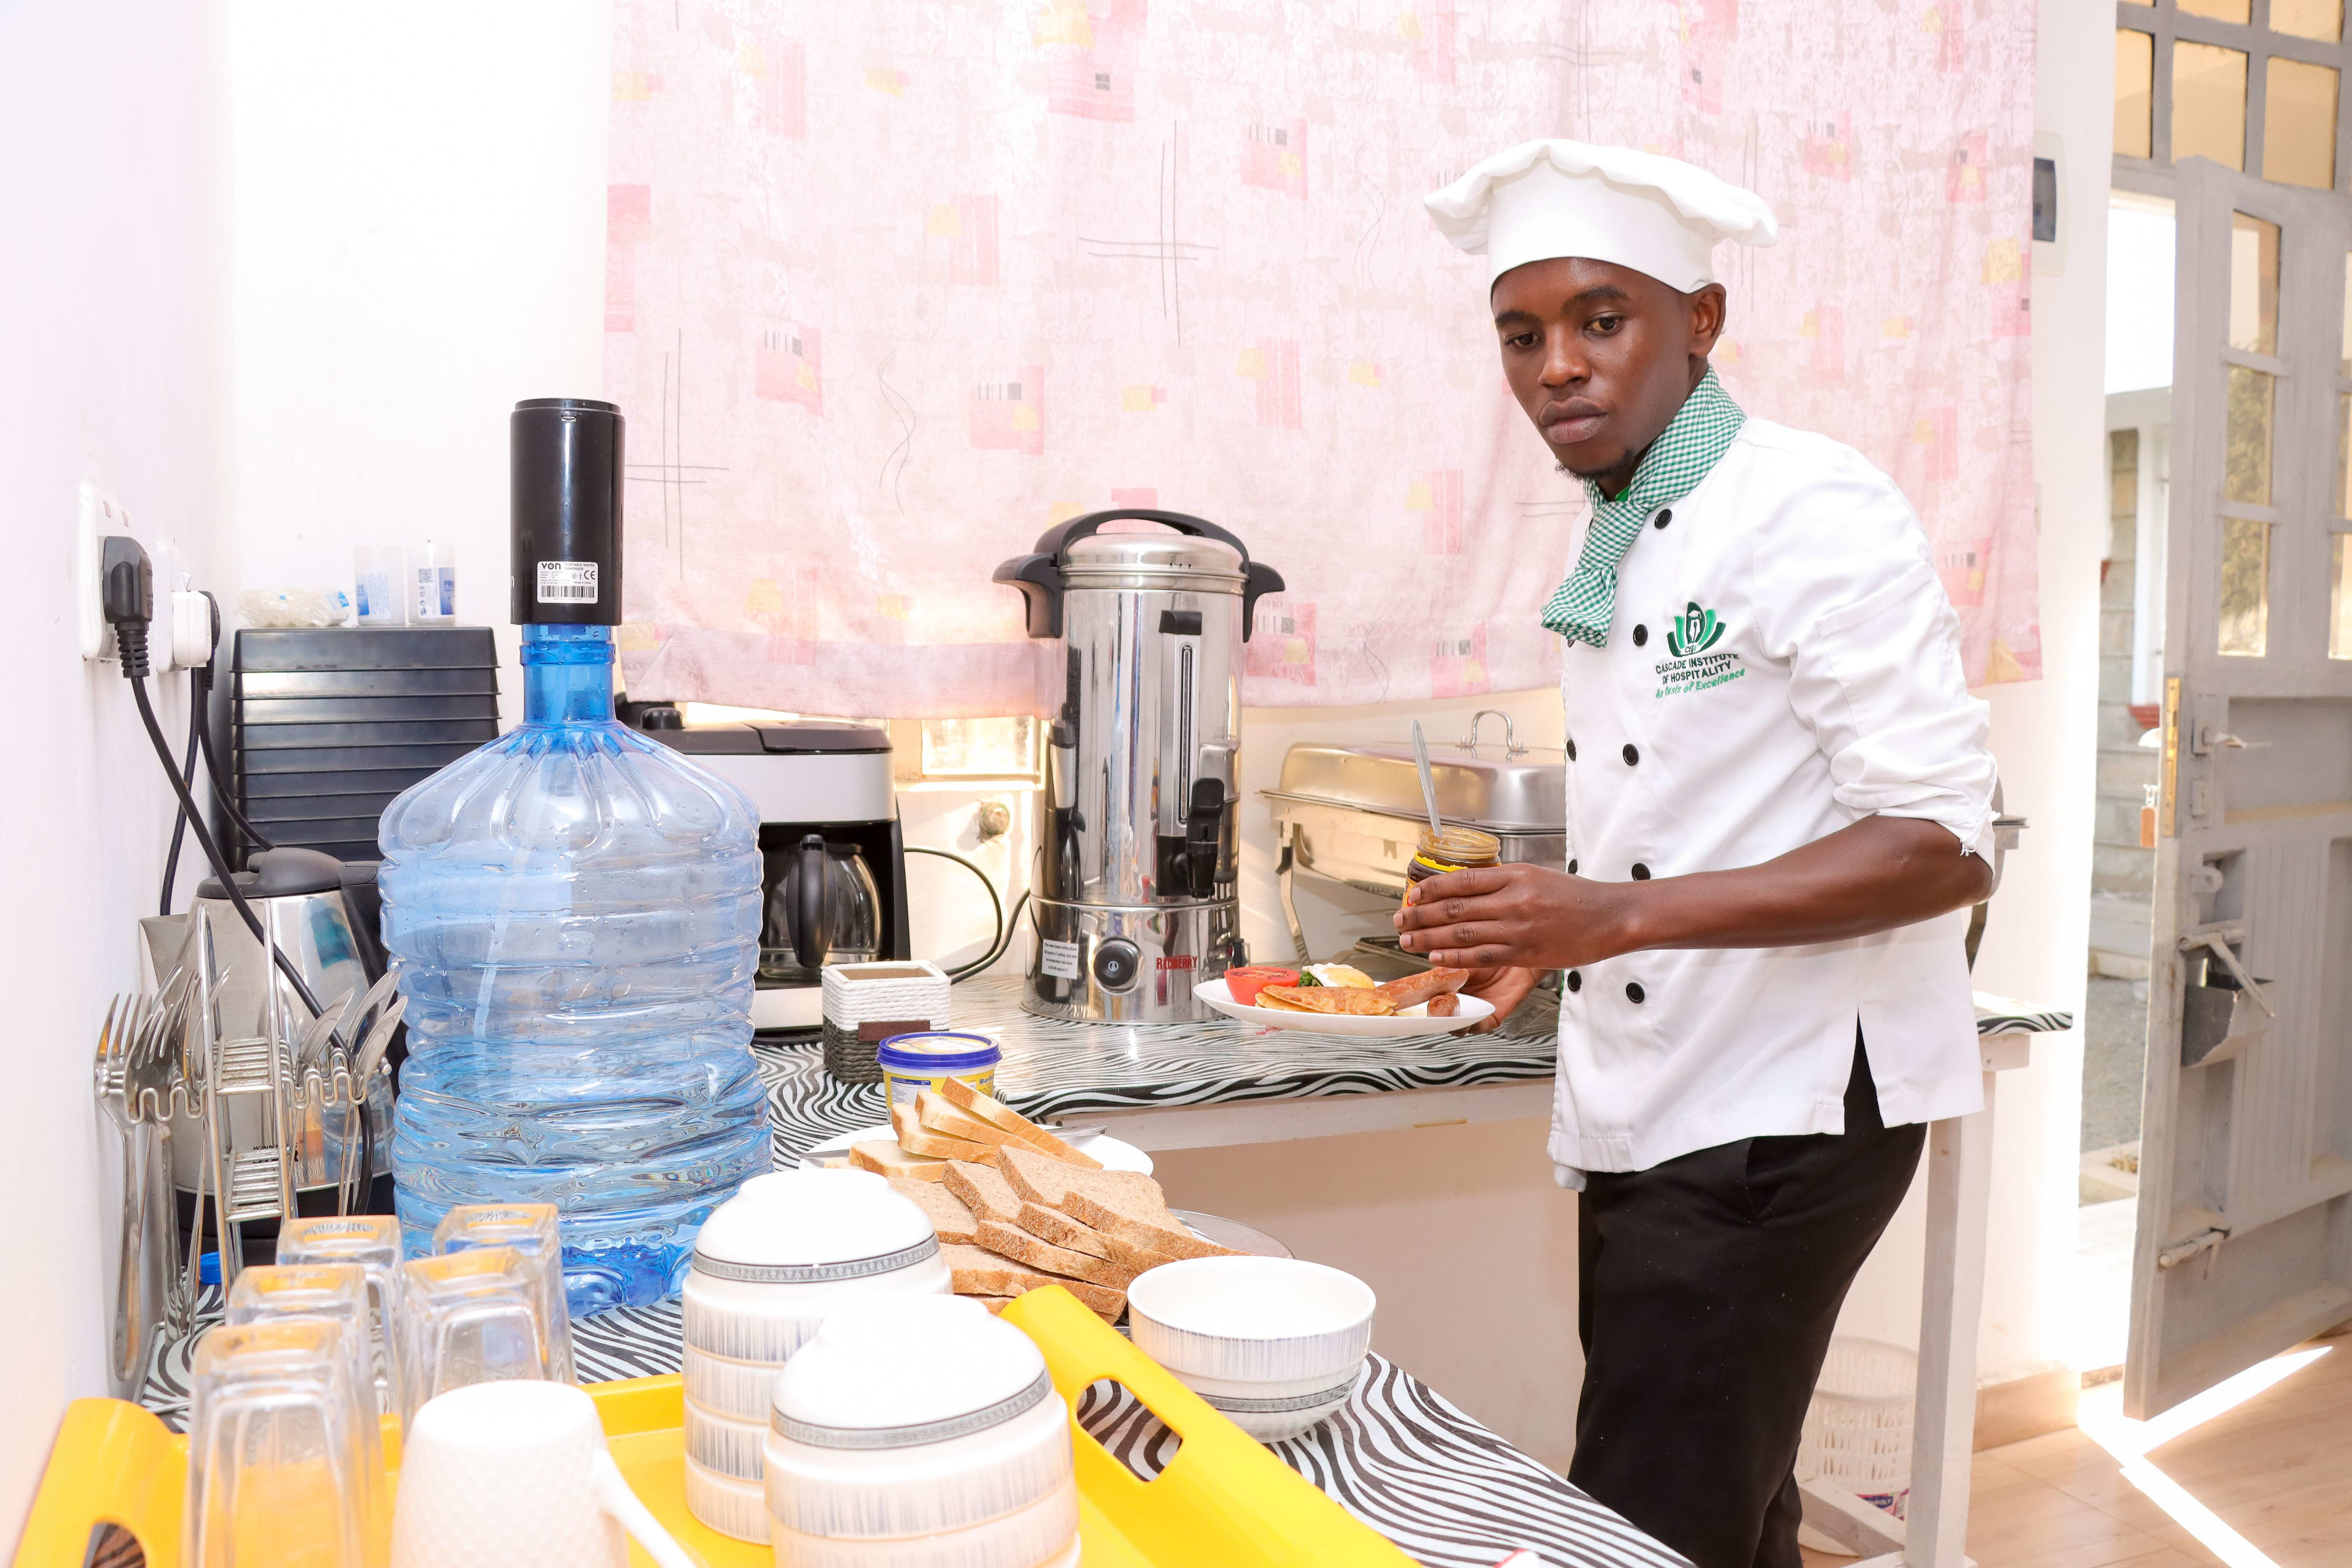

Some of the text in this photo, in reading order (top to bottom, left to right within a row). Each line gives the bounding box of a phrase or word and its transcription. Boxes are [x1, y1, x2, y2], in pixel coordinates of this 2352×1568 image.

[1656, 654, 1740, 674] CASCADE INSTITUTE
[1662, 660, 1731, 685] OF HOSPITALITY
[1684, 681, 1695, 693] of
[1696, 668, 1746, 690] Excellence
